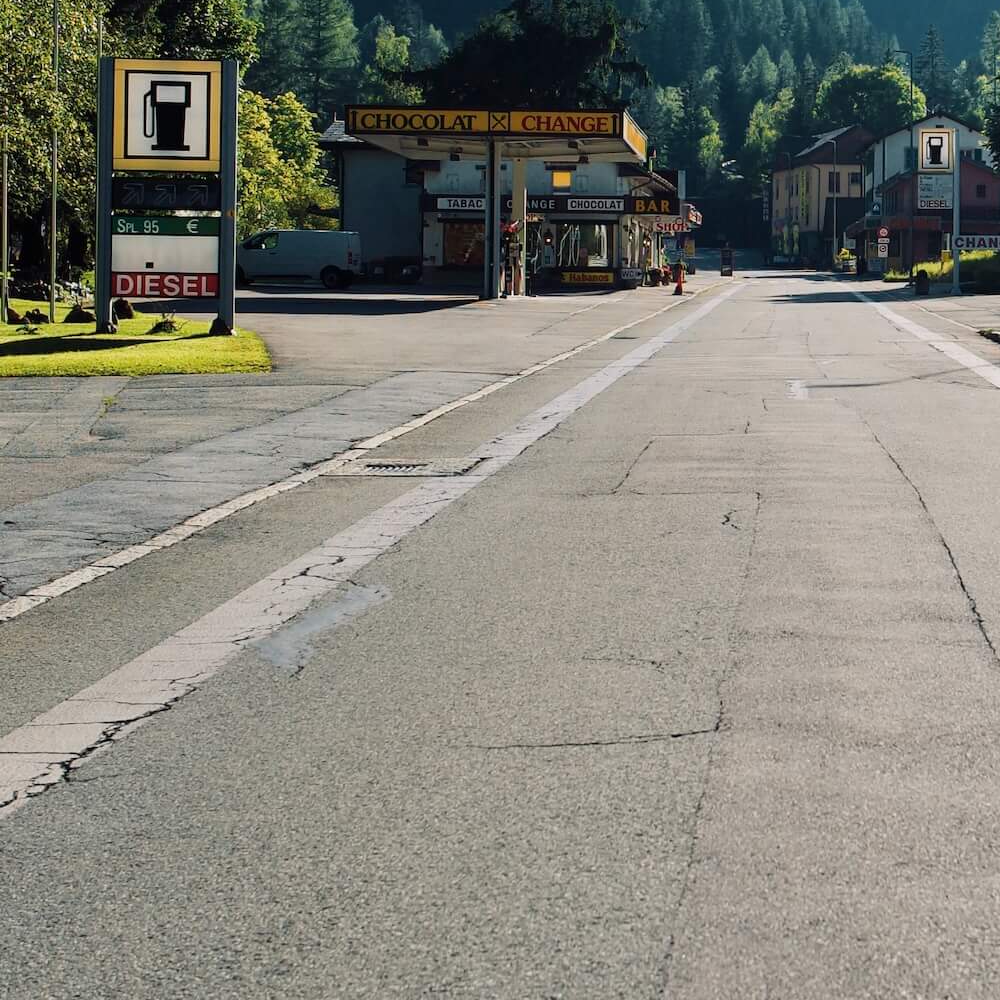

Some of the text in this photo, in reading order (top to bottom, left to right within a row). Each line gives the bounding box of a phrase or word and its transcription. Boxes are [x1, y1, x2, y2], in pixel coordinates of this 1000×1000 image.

[361, 113, 608, 133] CHOCOLAT CHANGE
[448, 199, 483, 209] TABAC
[506, 199, 556, 209] CNGE
[570, 199, 622, 209] CHOCOLAT
[635, 199, 671, 213] BAR
[920, 200, 952, 208] DIESEL
[143, 220, 159, 233] 95
[116, 274, 216, 297] DIESEL
